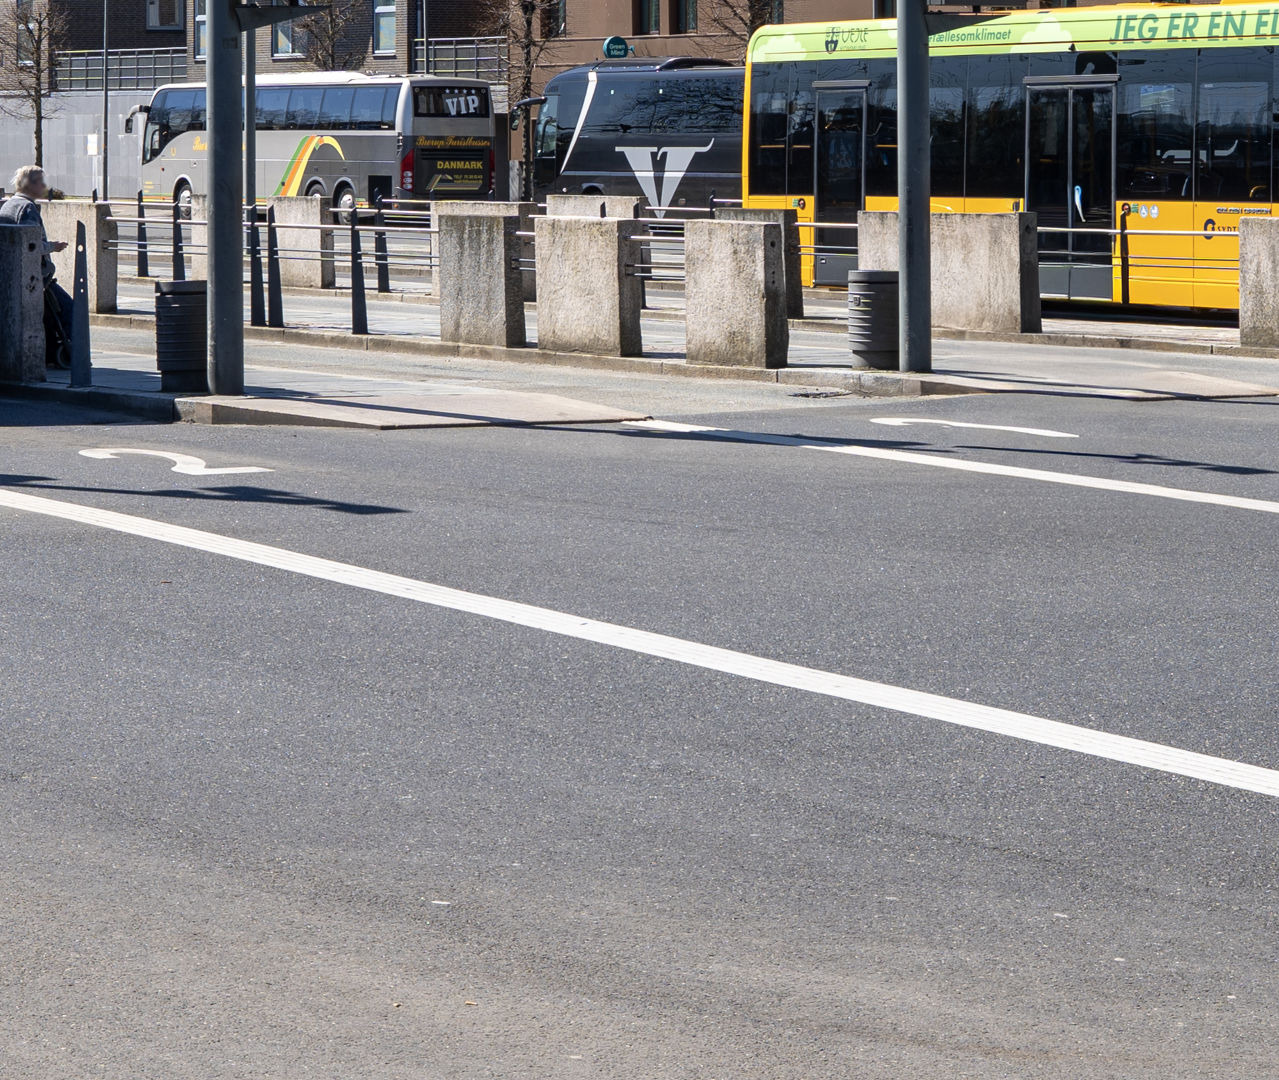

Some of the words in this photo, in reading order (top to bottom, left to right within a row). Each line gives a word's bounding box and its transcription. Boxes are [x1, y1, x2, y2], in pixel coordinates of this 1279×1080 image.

[1109, 13, 1160, 45] JEG
[1167, 12, 1200, 43] ER
[1207, 10, 1247, 42] EN
[446, 95, 479, 116] VIP
[437, 161, 483, 169] DANMARK
